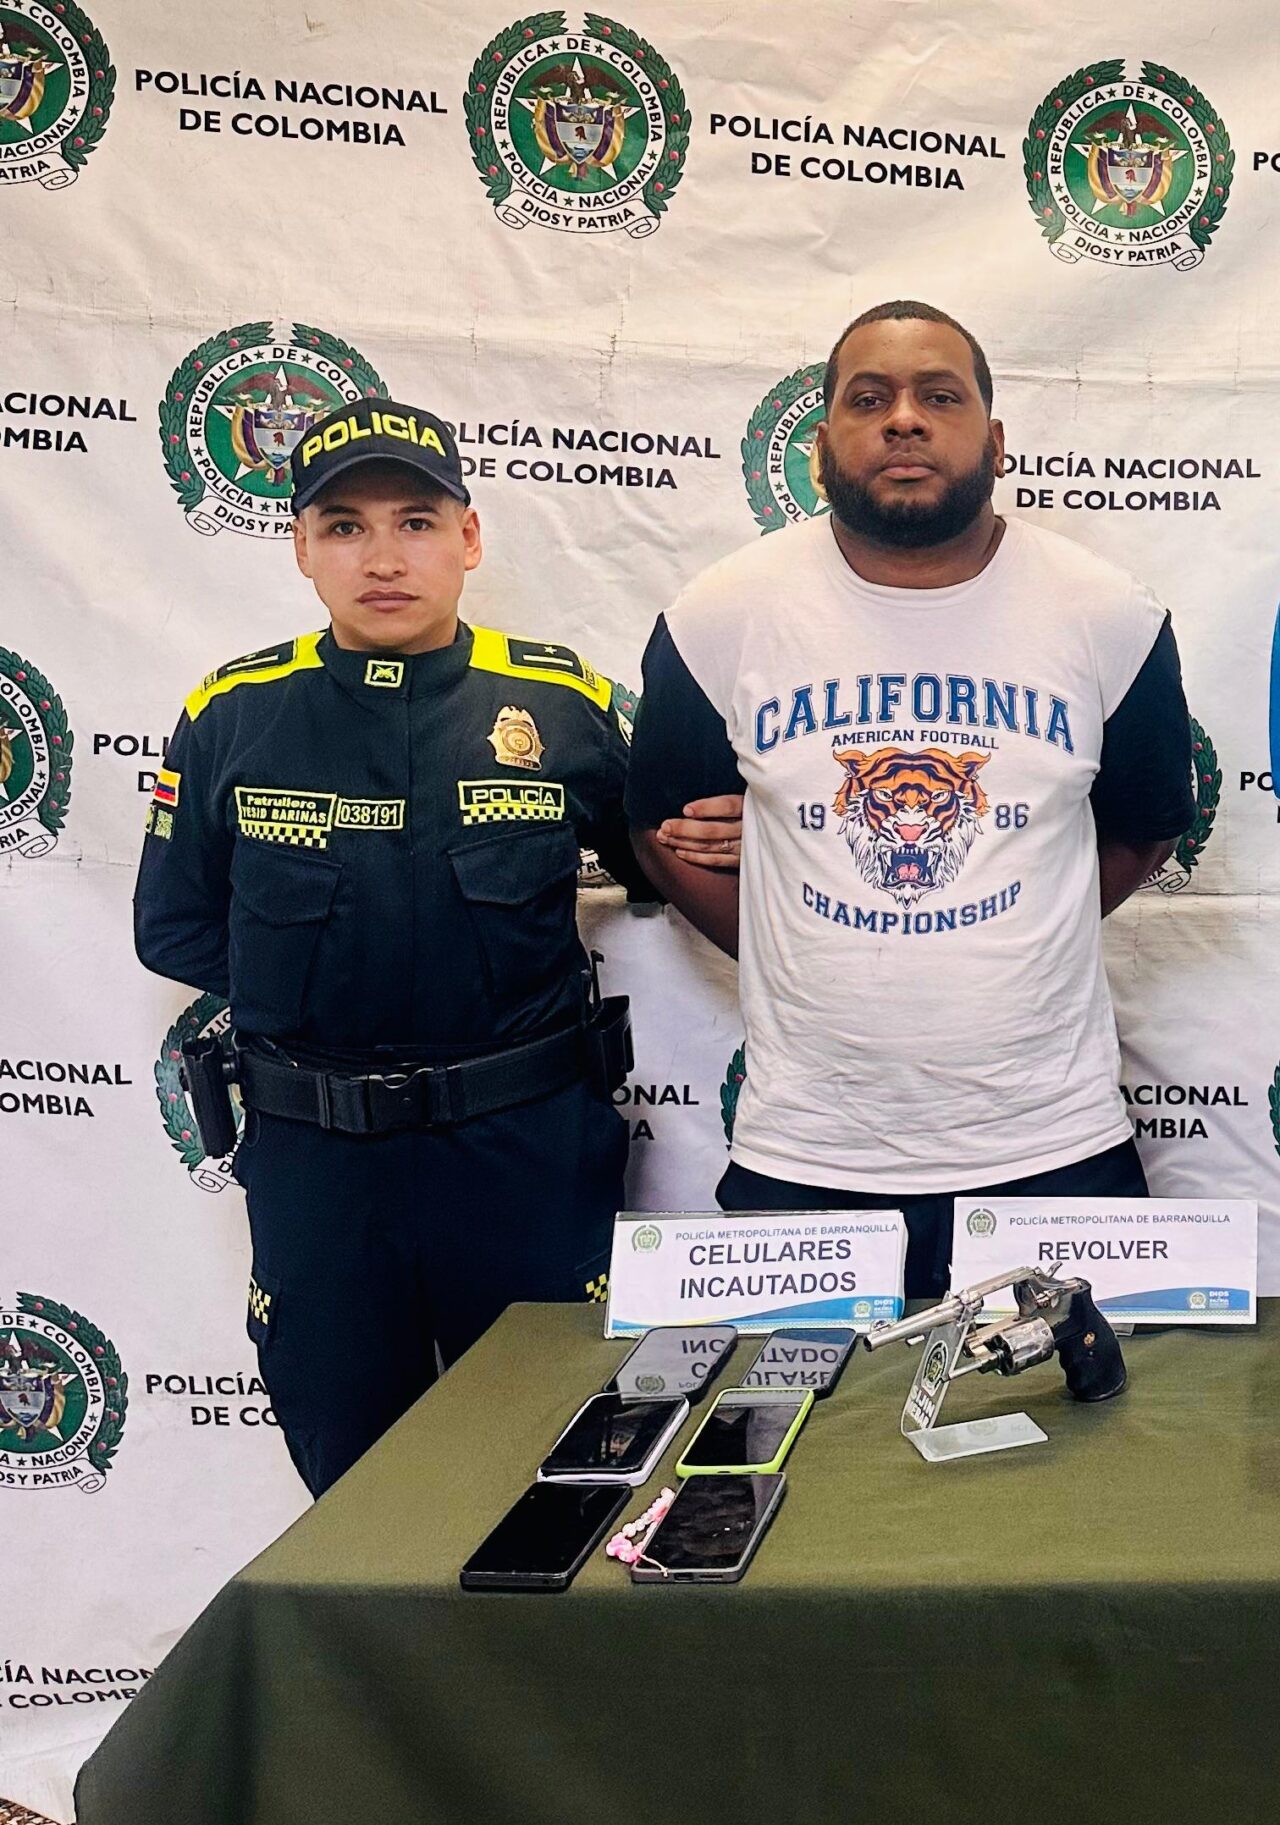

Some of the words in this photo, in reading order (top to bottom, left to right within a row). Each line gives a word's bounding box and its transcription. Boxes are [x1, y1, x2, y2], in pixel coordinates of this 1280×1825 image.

[29, 5, 87, 98] COLOMBIA
[135, 68, 266, 101] POLICÍA
[274, 79, 448, 114] NACIONAL
[494, 43, 549, 130] REPÚBLICA
[566, 37, 591, 52] DE
[609, 51, 663, 142] COLOMBIA
[179, 108, 221, 133] DE
[231, 112, 406, 147] COLOMBIA
[710, 113, 835, 145] POLICÍA
[843, 124, 1006, 159] NACIONAL
[1051, 90, 1107, 174] REPÚBLICA
[1123, 85, 1145, 99] DE
[1161, 98, 1208, 180] COLOMBIA
[503, 152, 558, 203] POLICÍA
[579, 163, 655, 208] NACIONAL
[751, 151, 791, 177] DE
[800, 156, 965, 191] COLOMBIA
[578, 207, 636, 229] PATRIA
[1058, 197, 1109, 239] POLICÍA
[1129, 198, 1200, 242] NACIONAL
[1127, 241, 1182, 261] PATRIA
[189, 352, 253, 437] REPÚBLICA
[272, 347, 297, 361] DE
[0, 392, 137, 422] CIONAL
[302, 411, 446, 467] POLICÍA
[552, 427, 721, 459] NACIONAL
[770, 391, 824, 475] REPÚBLICA
[506, 459, 678, 490] COLOMBIA
[1003, 451, 1096, 479] OLICÍA
[1104, 457, 1261, 479] NACIONAL
[197, 458, 254, 510] POLICÍA
[1016, 487, 1054, 509] DE
[1063, 489, 1222, 511] COLOMBIA
[754, 673, 1074, 755] CALIFORNIA
[831, 729, 914, 747] AMERICAN
[920, 730, 999, 750] FOOTBALL
[472, 787, 556, 806] POLICÍA
[271, 808, 327, 824] BARINAS
[341, 804, 398, 825] 038191
[798, 803, 826, 830] 19
[994, 803, 1030, 830] 86
[802, 880, 1022, 935] CHAMPIONSHIP
[0, 1058, 133, 1085] ACIONAL
[0, 1092, 95, 1118] OMBIA
[614, 1084, 700, 1107] ONAL
[1136, 1117, 1209, 1140] MBIA
[675, 1229, 715, 1241] POLICÍA
[718, 1226, 801, 1239] METROPOLITANA
[804, 1225, 819, 1236] DE
[820, 1223, 898, 1235] BARRANQUILLA
[1009, 1215, 1048, 1226] POLICÍA
[1050, 1215, 1134, 1225] METROPOLITANA
[1136, 1215, 1150, 1224] DE
[1152, 1214, 1231, 1224] BARRANQUILLA
[689, 1239, 852, 1266] CELULARES
[1038, 1240, 1169, 1261] REVOLVER
[680, 1271, 857, 1299] INCAUTADOS
[2, 1314, 25, 1326] DE
[43, 1325, 102, 1405] COLOMBIA
[145, 1371, 267, 1397] POLICÍA
[190, 1406, 231, 1427] DE
[32, 1423, 96, 1467] NACIONAL
[33, 1465, 84, 1485] PATRIA
